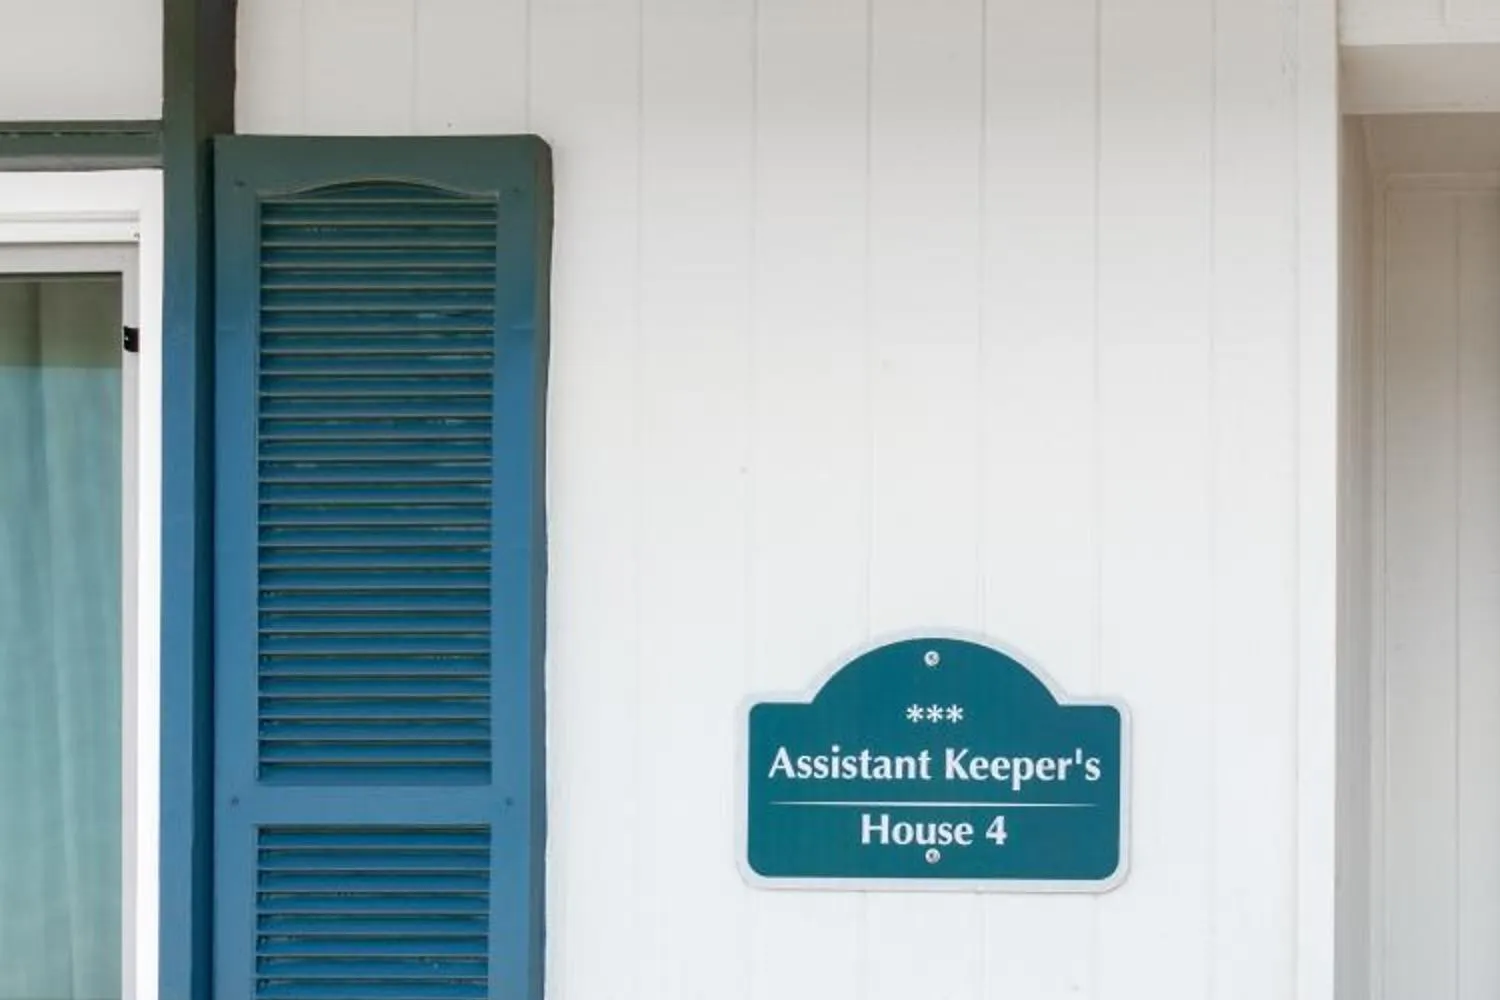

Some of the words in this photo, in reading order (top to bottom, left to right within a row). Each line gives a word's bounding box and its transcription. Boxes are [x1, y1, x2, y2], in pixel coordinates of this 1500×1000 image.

[768, 744, 932, 780] Assistant
[945, 747, 1101, 791] Keeper's
[861, 813, 974, 846] House
[985, 815, 1008, 845] 4
